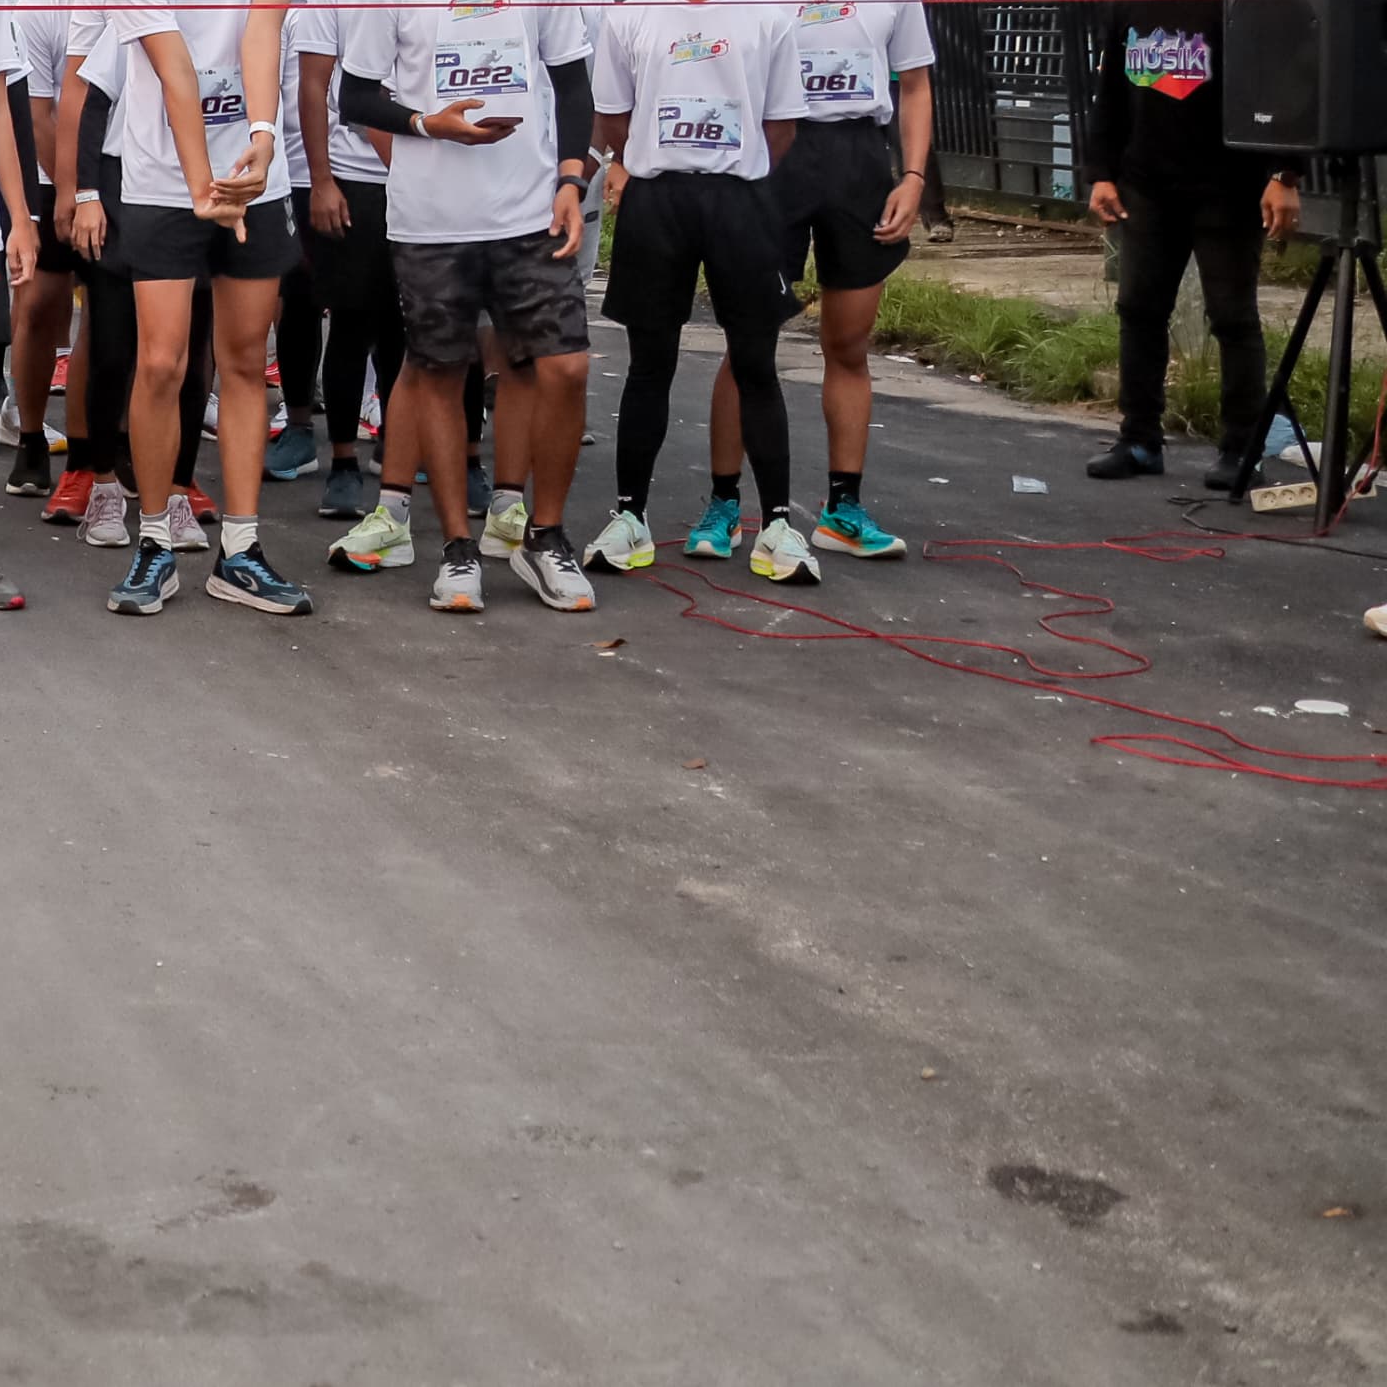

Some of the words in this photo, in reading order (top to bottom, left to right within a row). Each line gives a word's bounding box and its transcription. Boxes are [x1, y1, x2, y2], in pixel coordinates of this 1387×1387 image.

[448, 65, 514, 87] 022
[806, 74, 858, 92] 061
[201, 94, 242, 115] 02
[672, 121, 724, 141] 018
